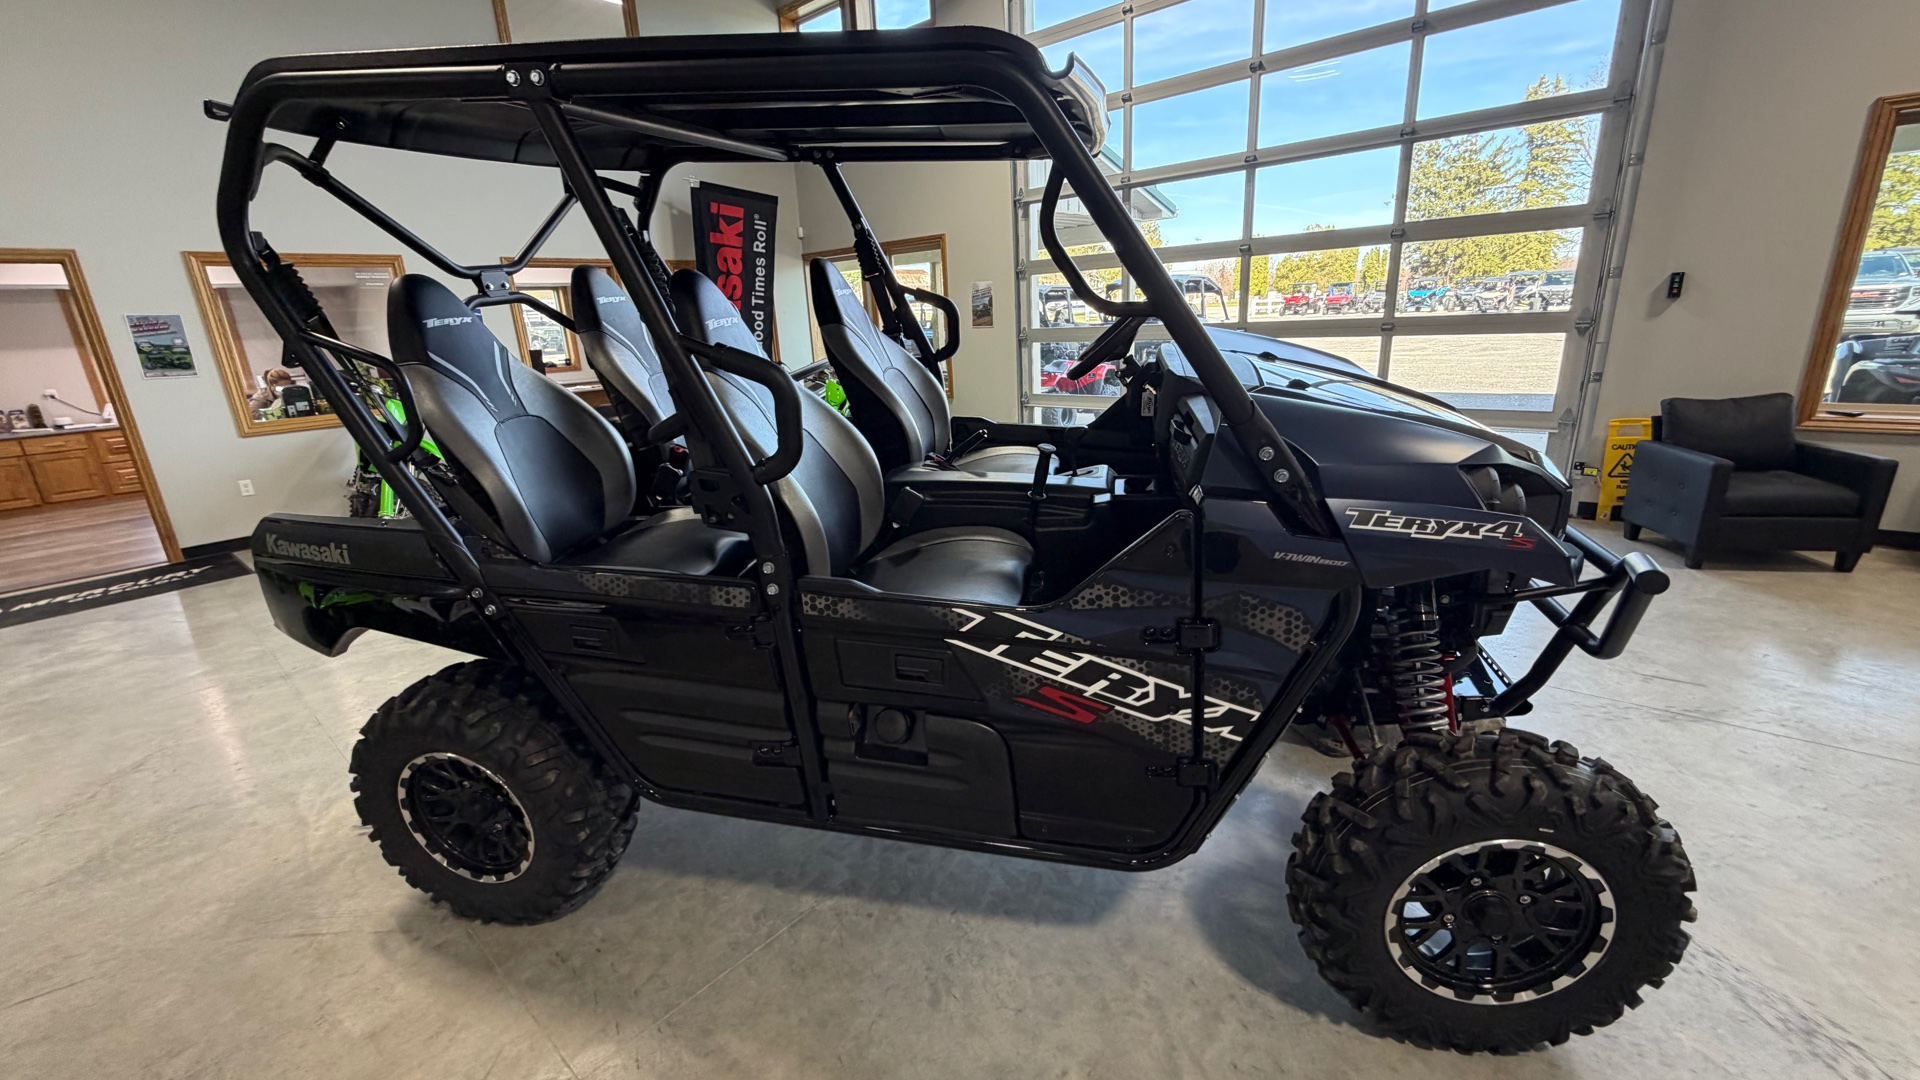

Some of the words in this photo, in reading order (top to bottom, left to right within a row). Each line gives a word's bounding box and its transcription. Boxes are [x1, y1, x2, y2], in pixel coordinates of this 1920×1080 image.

[710, 202, 744, 311] saki
[751, 257, 766, 306] Times
[752, 311, 764, 348] ood
[266, 532, 351, 564] Kawasaki
[9, 564, 214, 612] MERCURY
